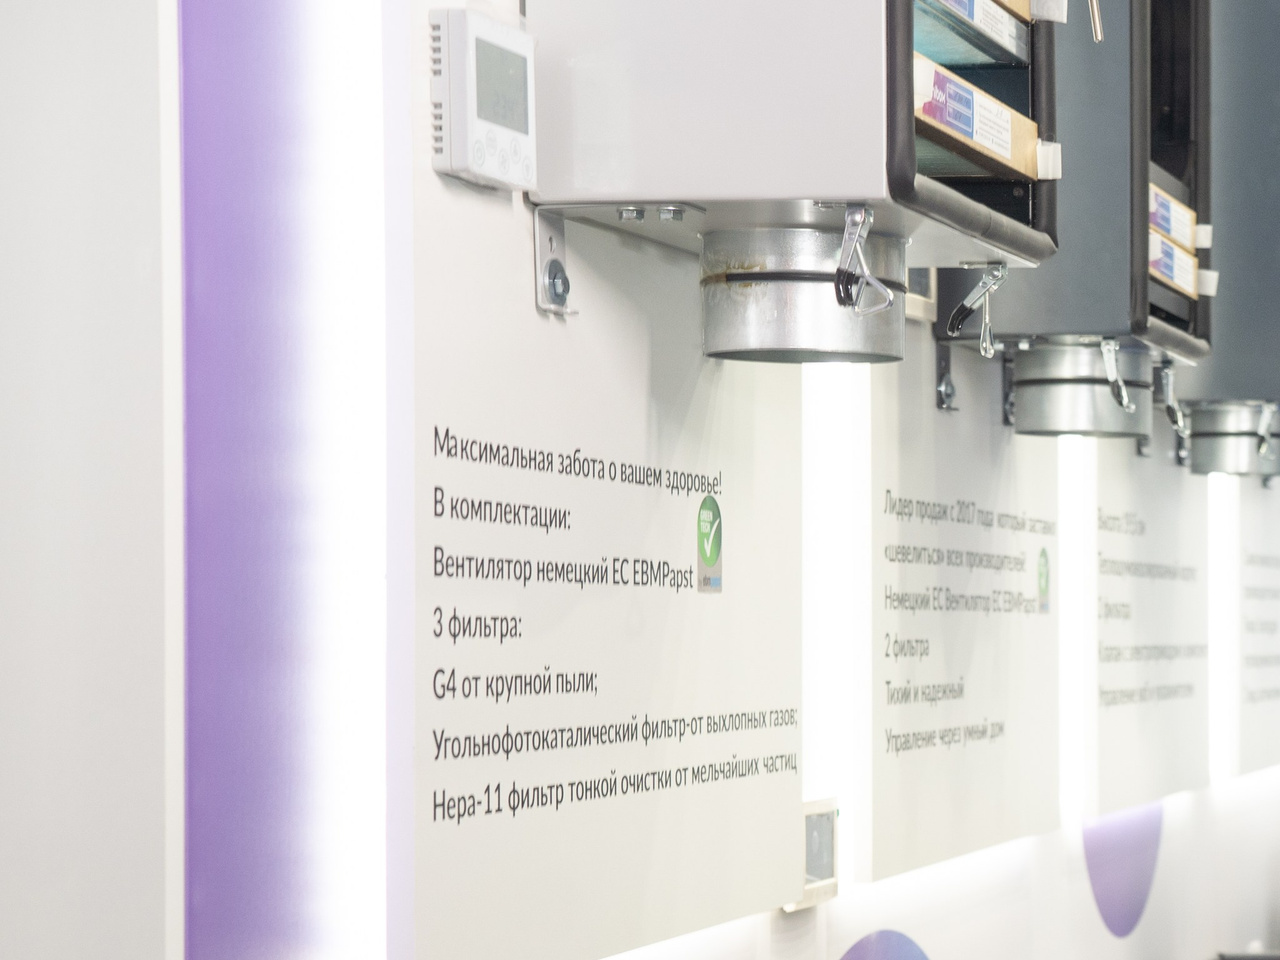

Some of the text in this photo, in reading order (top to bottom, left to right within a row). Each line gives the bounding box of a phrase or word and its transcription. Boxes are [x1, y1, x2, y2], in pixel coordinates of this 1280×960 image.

[434, 425, 722, 497] Максимальная забота о вашем здоровье!
[434, 486, 571, 535] В комплектации:
[884, 489, 914, 523] Лидер
[916, 500, 949, 525] продаж
[956, 501, 976, 525] 2017
[434, 545, 532, 587] Вентилятор
[536, 556, 609, 590] немецкий
[632, 560, 694, 593] EBMPapst
[885, 584, 931, 616] Немецкий
[433, 606, 522, 645] 3 фильтра:
[885, 632, 930, 663] 2 фильтра
[433, 664, 598, 704] G4 от крупной пыли;
[885, 679, 912, 706] Тихий
[921, 675, 964, 707] надежный
[433, 714, 638, 761] Угольнофотокаталический
[706, 711, 767, 734] выхлопных
[769, 707, 798, 729] газов;
[885, 728, 937, 757] Управление
[939, 727, 961, 750] через
[508, 781, 564, 817] фильтр
[568, 769, 617, 803] тонкой
[621, 769, 672, 795] очистки
[675, 767, 689, 787] от
[692, 753, 760, 785] мельчайших
[763, 752, 798, 775] частиц
